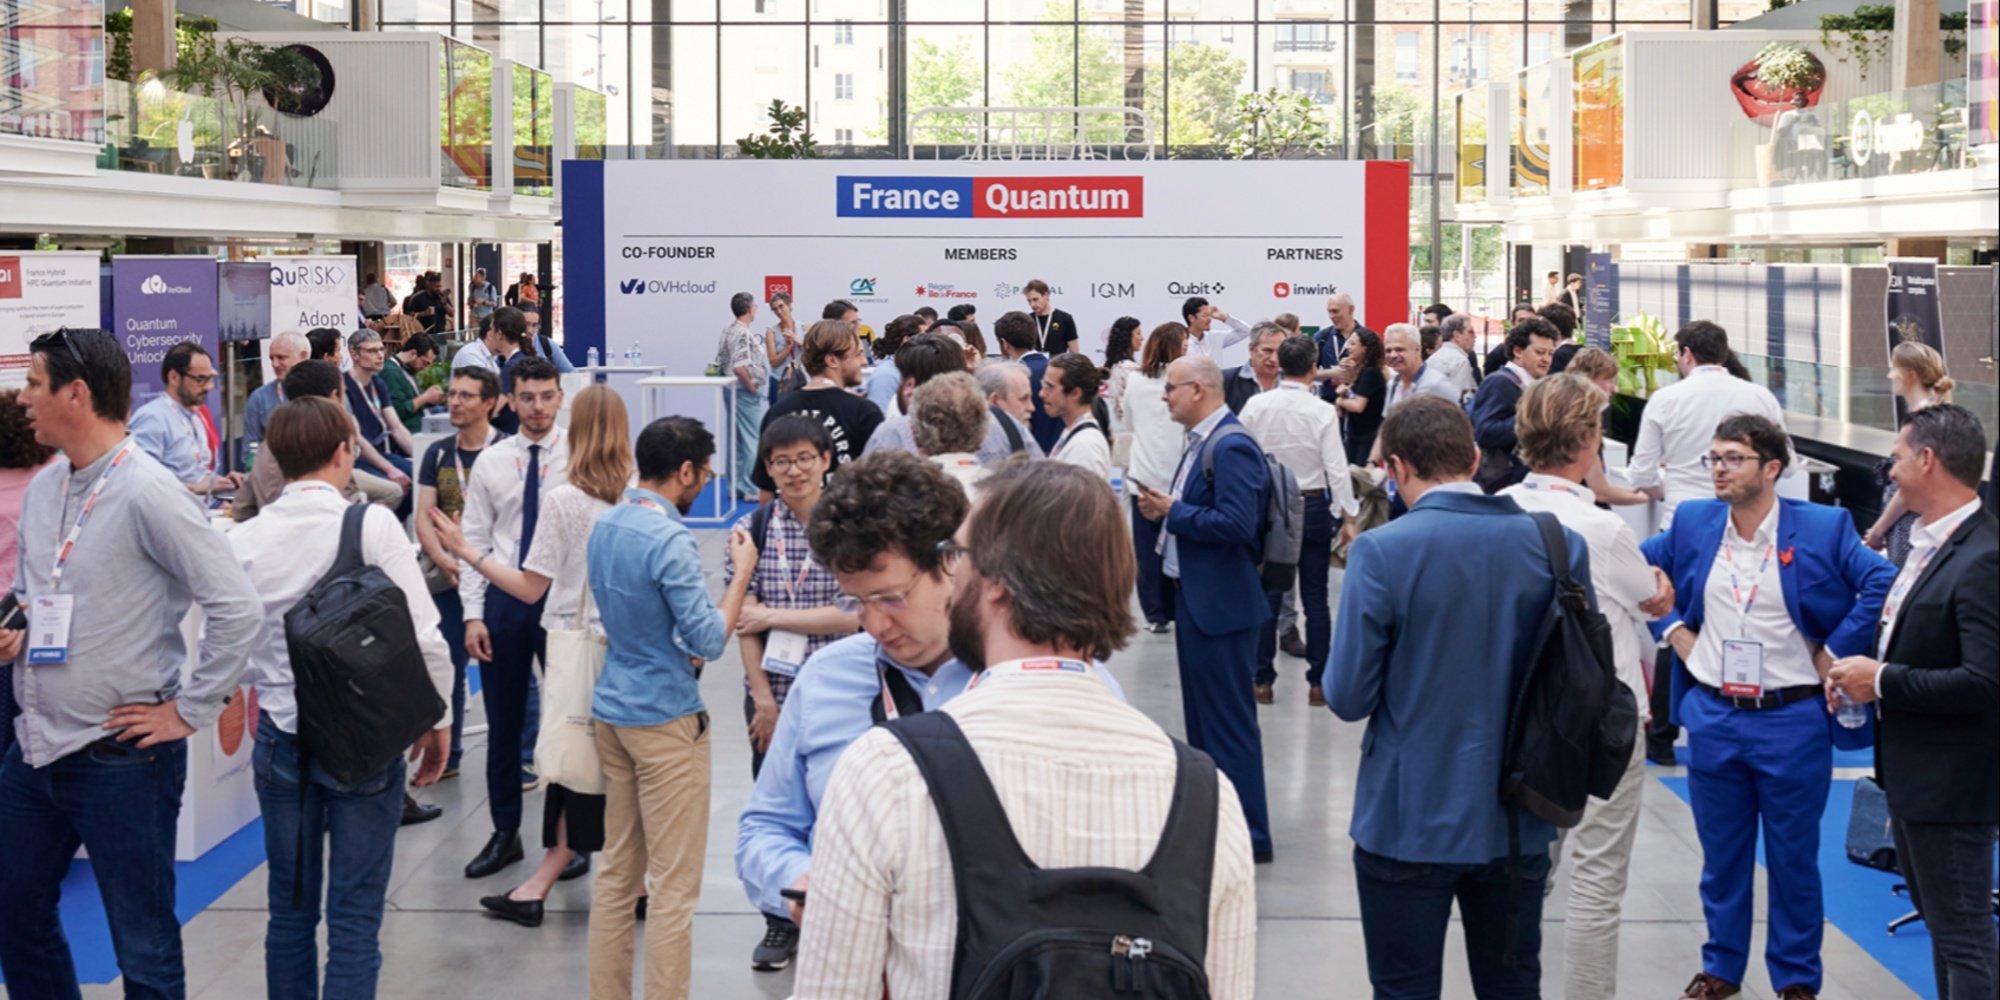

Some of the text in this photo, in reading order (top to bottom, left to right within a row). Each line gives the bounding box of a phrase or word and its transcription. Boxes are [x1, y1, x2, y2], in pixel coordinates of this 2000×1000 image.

[854, 183, 1129, 214] France Quantum
[622, 247, 715, 259] CO-FOUNDER
[945, 248, 1017, 260] MEMBERS
[1267, 248, 1343, 261] PARTNERS
[41, 279, 67, 287] Quantum
[648, 280, 716, 293] OVHcloud
[927, 282, 954, 291] Région
[1168, 282, 1210, 295] Qubit
[1293, 283, 1337, 295] inwink
[1012, 286, 1064, 295] PAL
[1092, 283, 1135, 298] IQM
[127, 318, 177, 331] Quantum
[298, 311, 346, 329] Adopt
[127, 332, 203, 350] Cybersecurity
